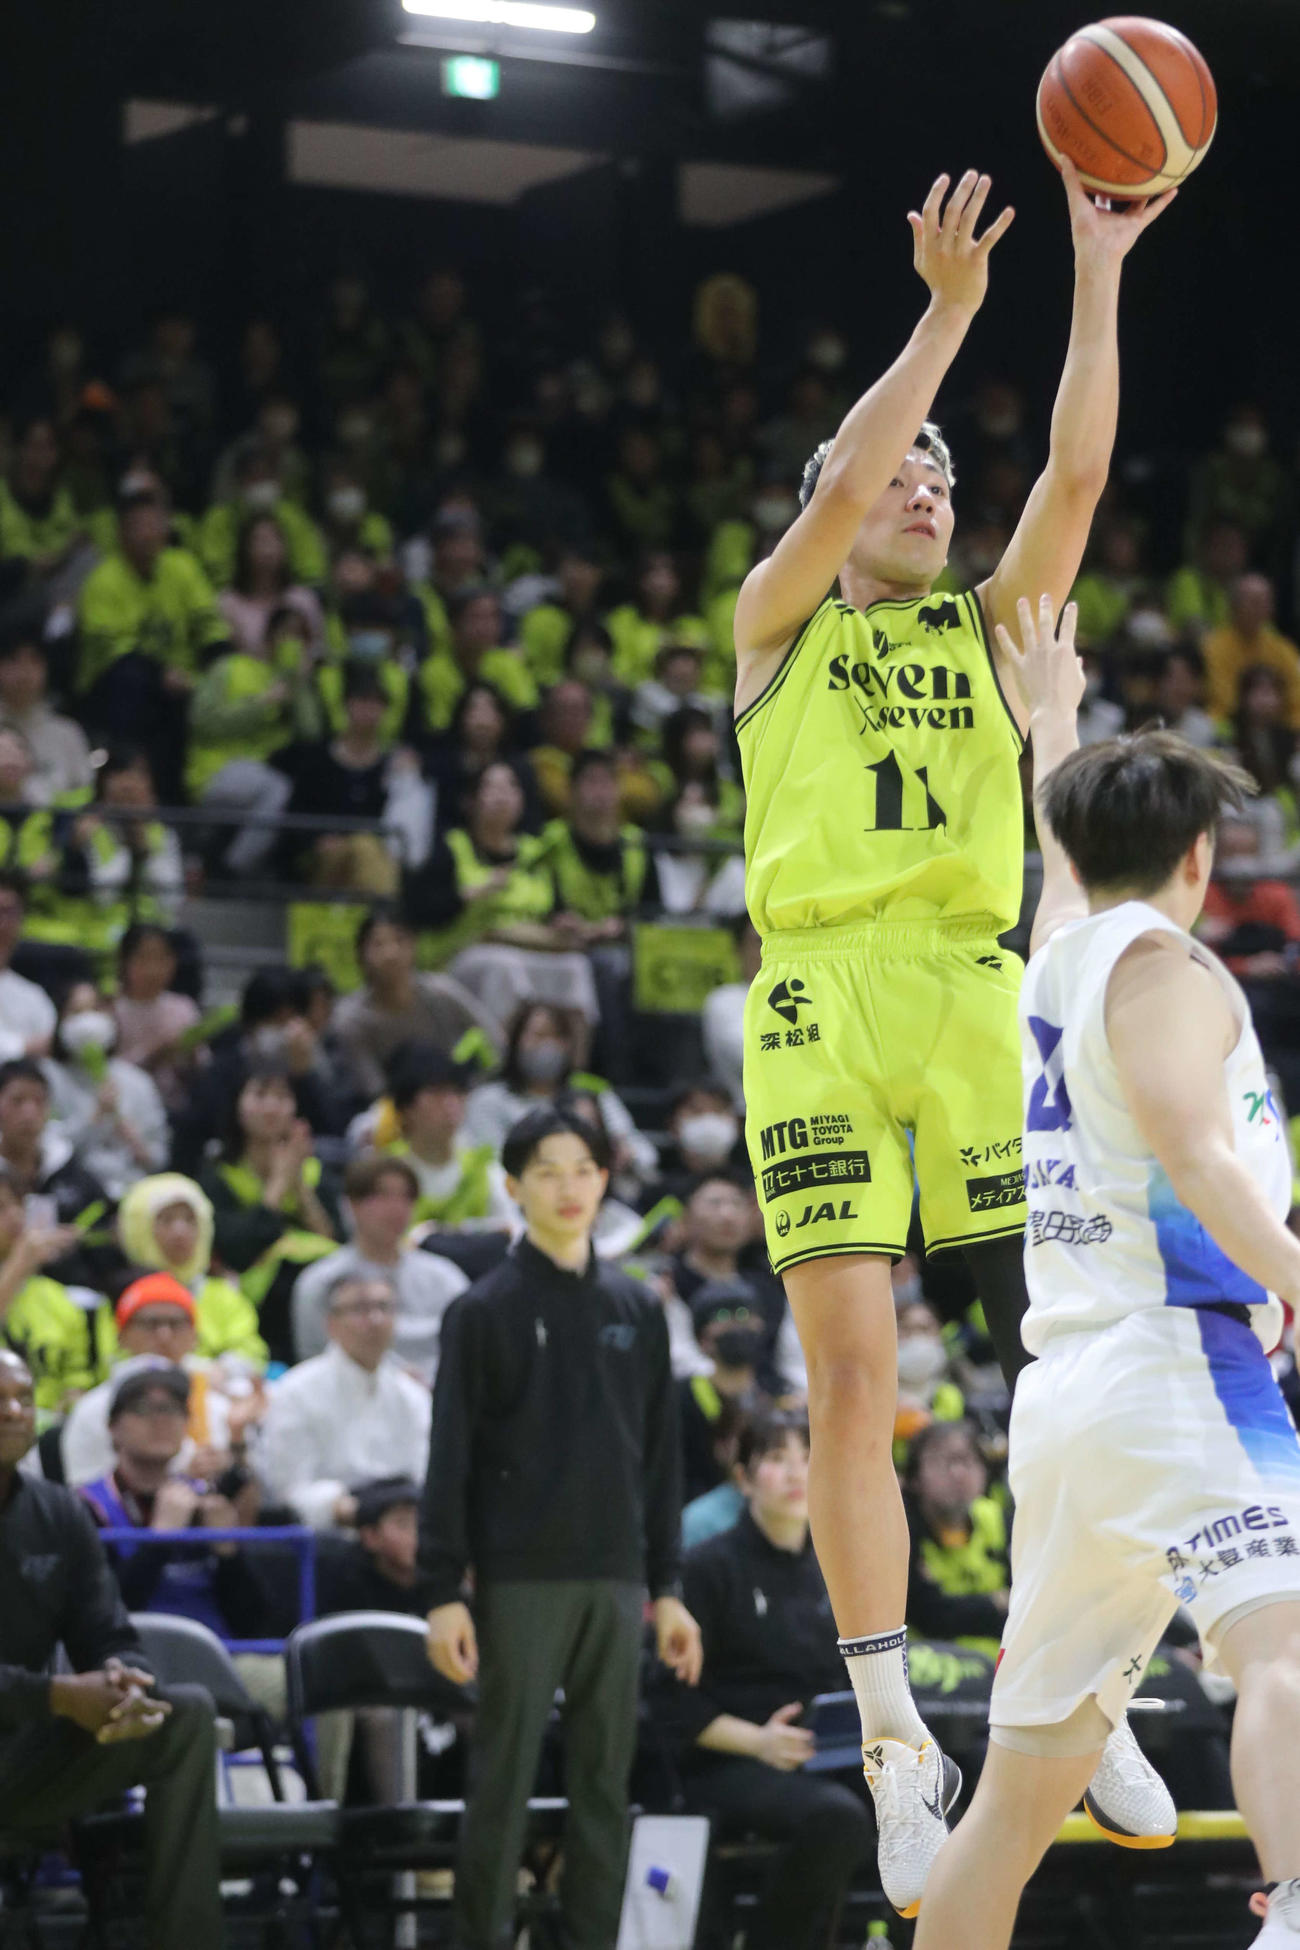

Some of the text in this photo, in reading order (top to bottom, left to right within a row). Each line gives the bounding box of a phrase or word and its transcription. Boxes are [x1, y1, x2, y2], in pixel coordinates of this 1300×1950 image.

[827, 653, 975, 701] Seven
[878, 705, 976, 730] seven
[760, 1023, 821, 1051] 深松組
[809, 1113, 850, 1126] MIYAGI
[811, 1123, 854, 1136] TOYOTA
[760, 1117, 809, 1161] MTG
[812, 1136, 845, 1146] Group
[775, 1158, 866, 1188] 七十七銀行
[795, 1200, 859, 1229] JAL
